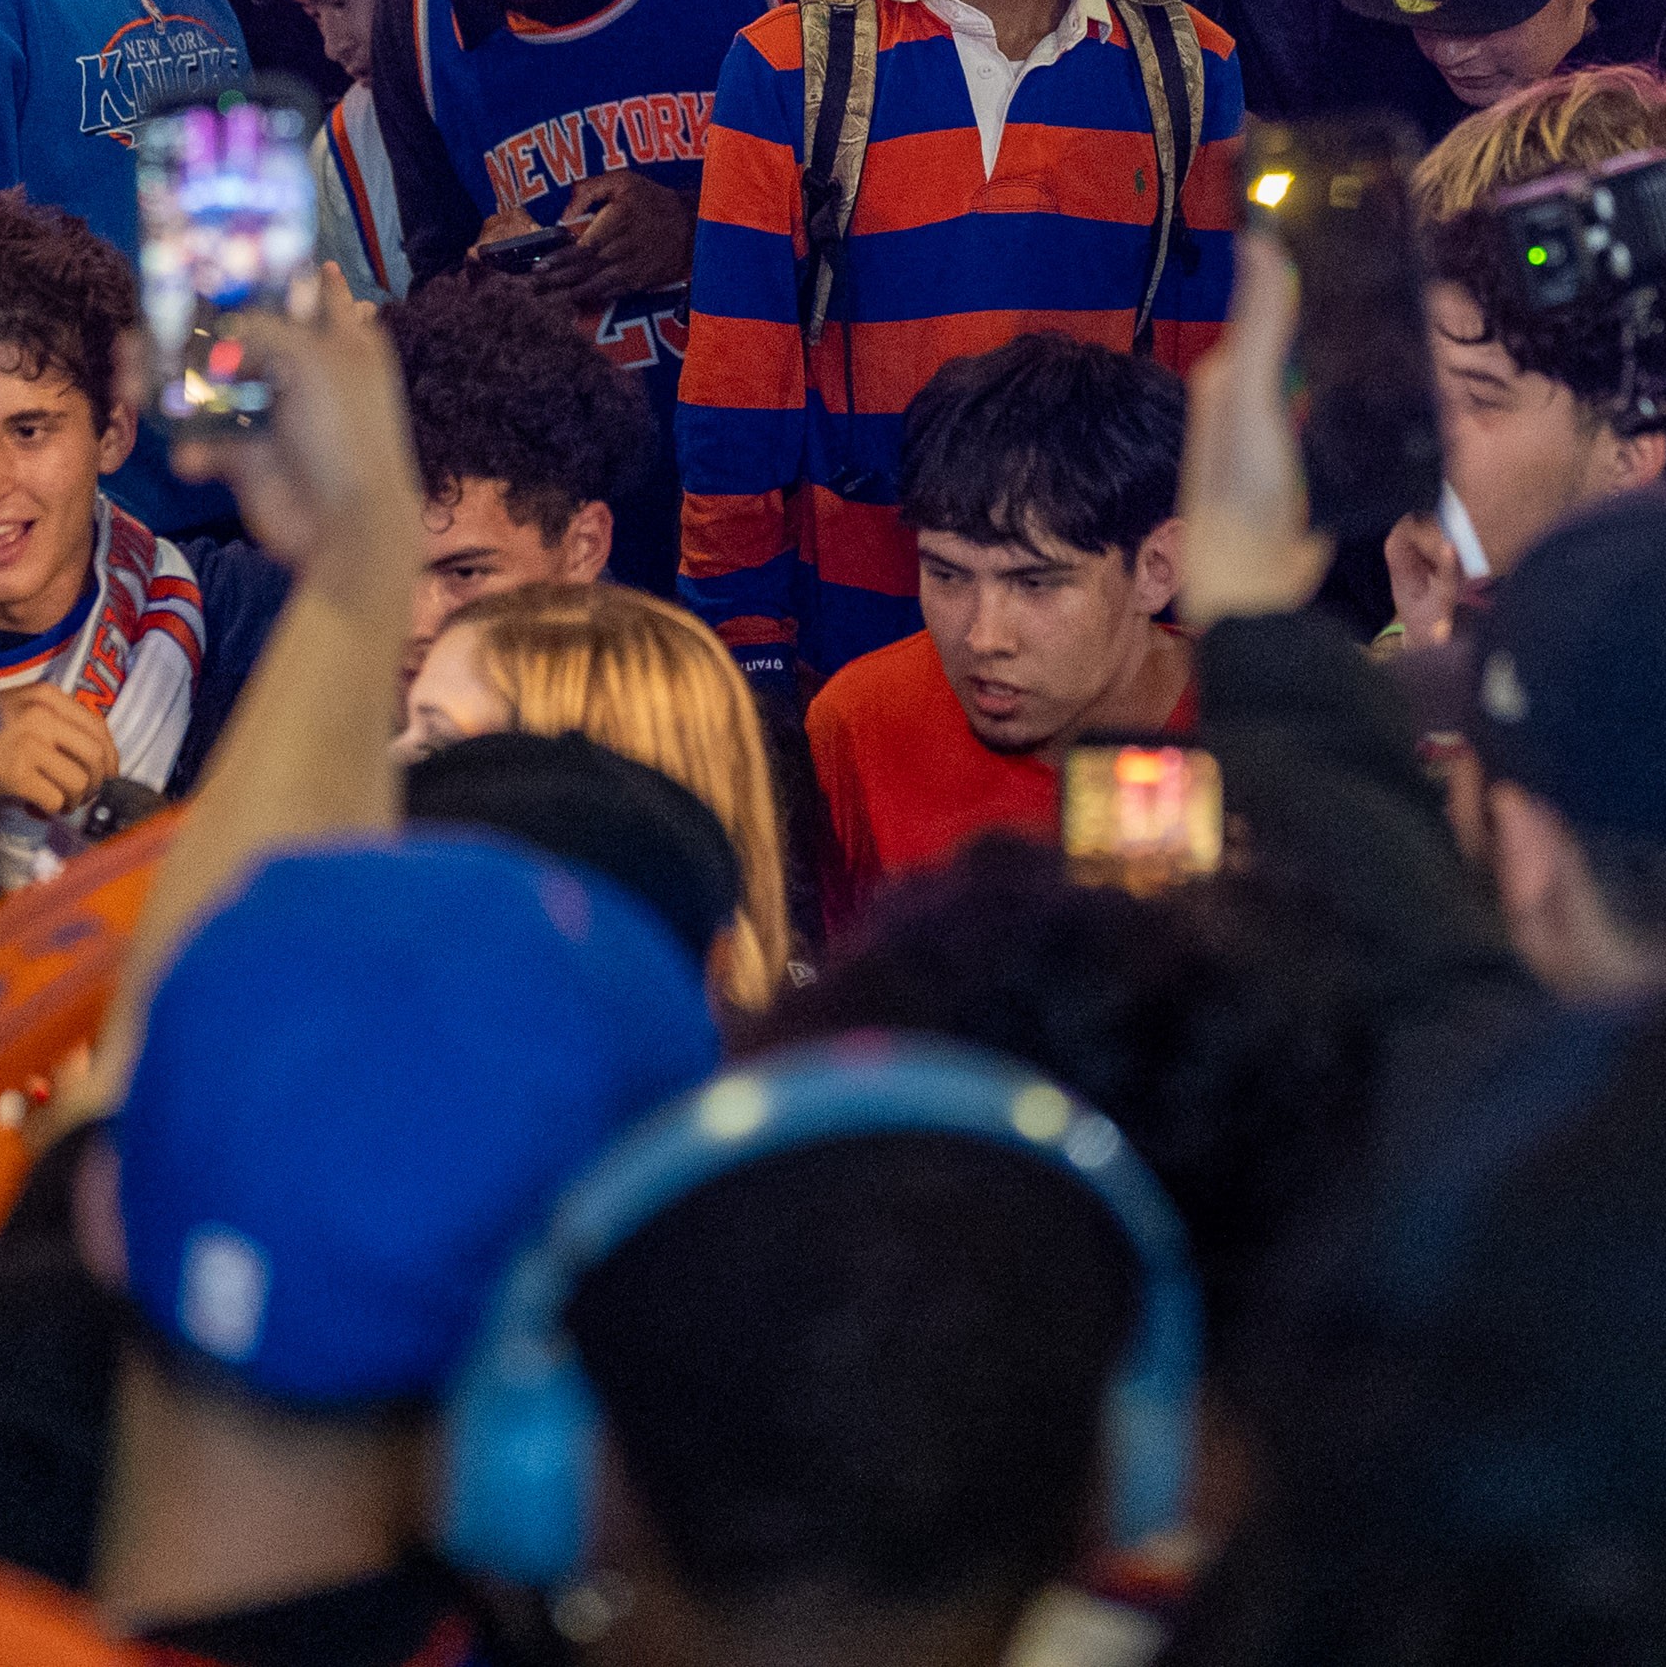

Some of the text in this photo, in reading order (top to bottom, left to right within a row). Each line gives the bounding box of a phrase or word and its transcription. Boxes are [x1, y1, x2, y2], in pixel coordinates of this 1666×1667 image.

[124, 29, 206, 59] NEW YORK
[484, 91, 717, 214] NEW YORK
[75, 606, 126, 717] NE
[740, 658, 772, 672] FAIT
